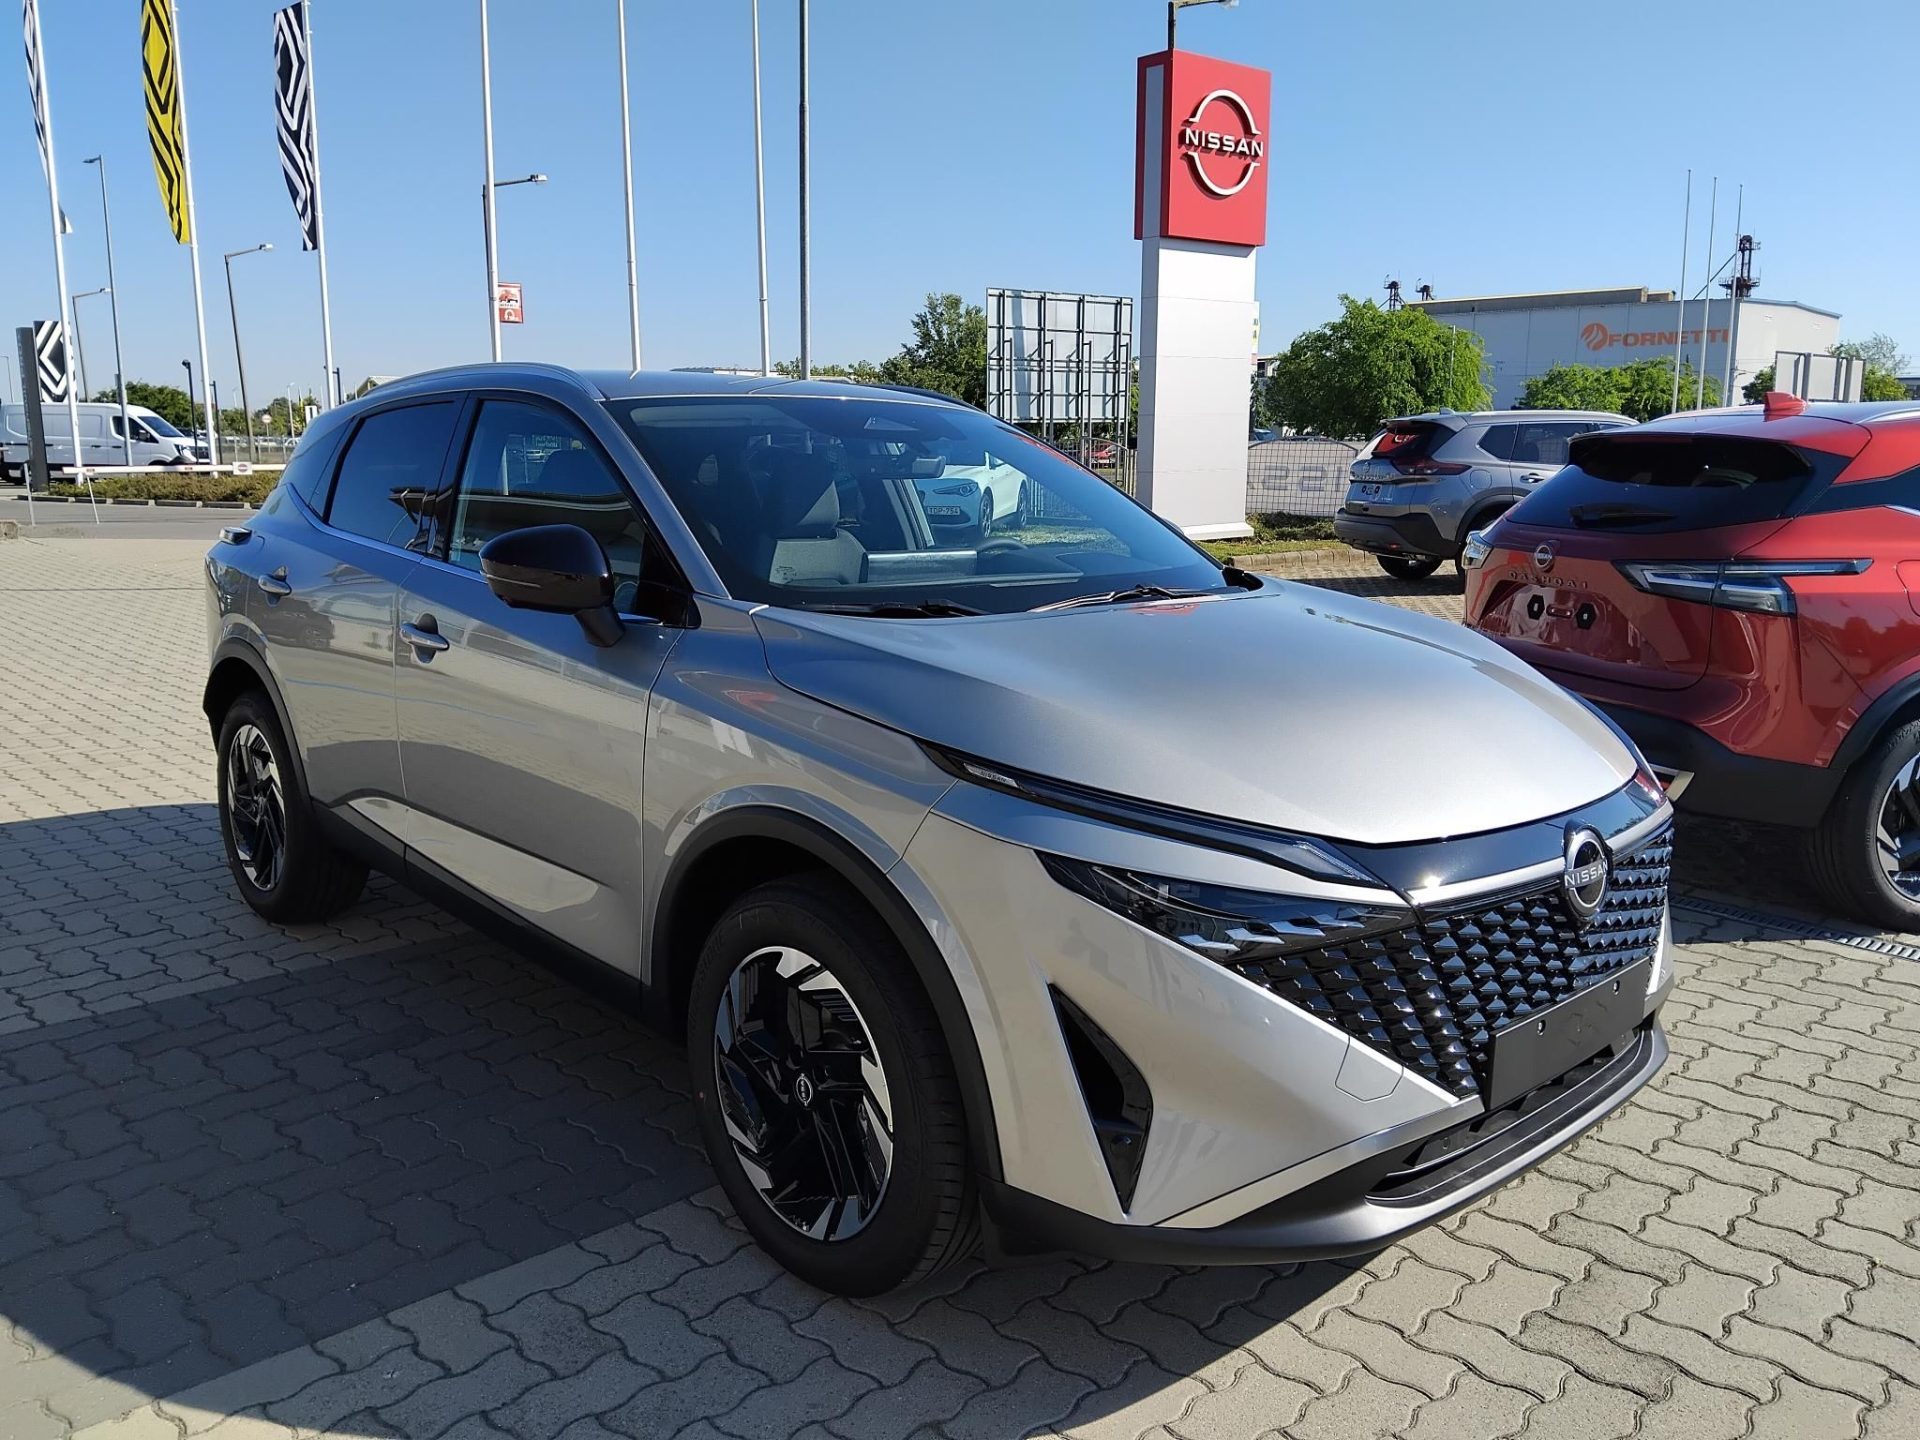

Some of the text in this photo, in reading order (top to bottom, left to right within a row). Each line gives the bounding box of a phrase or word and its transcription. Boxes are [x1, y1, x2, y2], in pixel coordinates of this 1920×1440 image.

[1185, 127, 1265, 158] NISSAN
[1608, 328, 1731, 348] FORNETTI
[1509, 570, 1588, 589] QASHQAI
[1564, 859, 1608, 887] NISSAN
